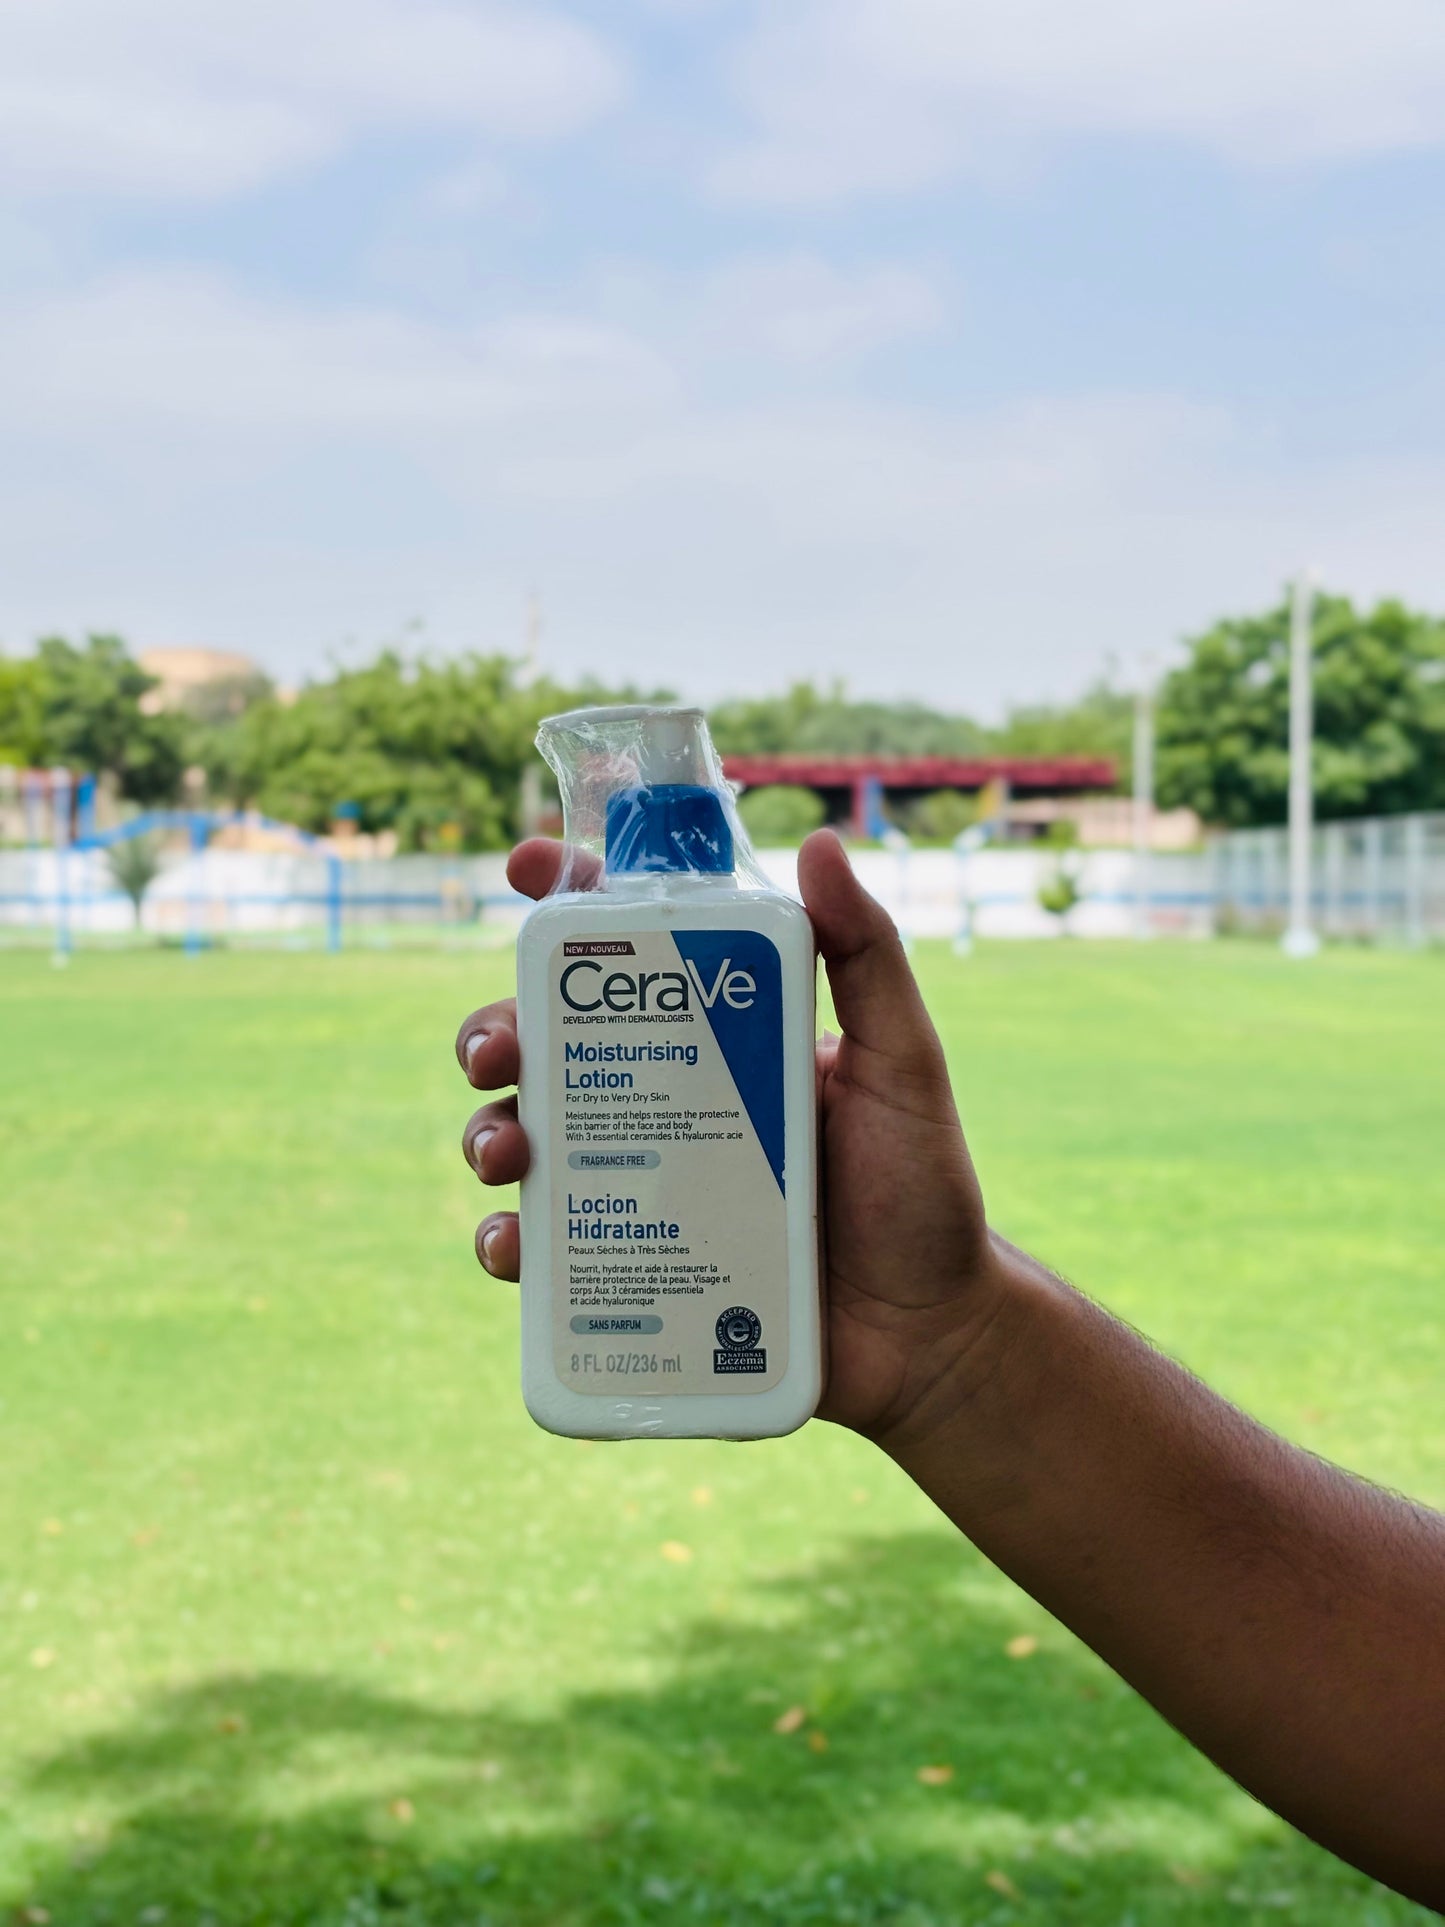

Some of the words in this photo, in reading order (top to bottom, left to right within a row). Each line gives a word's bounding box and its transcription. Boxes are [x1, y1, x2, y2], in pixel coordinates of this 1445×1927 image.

[590, 945, 628, 954] NOUVEAU
[560, 958, 756, 1012] CeraVe
[563, 1016, 606, 1024] DEVELOPED
[608, 1015, 626, 1024] WITH
[628, 1014, 694, 1024] DERMATOLOGISTS
[565, 1041, 698, 1066] Moisturising
[566, 1068, 634, 1088] Lotion
[566, 1094, 581, 1102] For
[583, 1094, 598, 1104] Dry
[600, 1094, 610, 1102] to
[612, 1093, 630, 1104] Very
[633, 1093, 648, 1104] Dry
[650, 1092, 670, 1102] Skin
[613, 1110, 628, 1120] and
[630, 1110, 651, 1121] helps
[653, 1110, 682, 1119] restore
[684, 1110, 697, 1118] the
[699, 1110, 740, 1120] protective
[566, 1122, 582, 1130] skin
[584, 1122, 611, 1130] barrier
[613, 1121, 622, 1130] of
[623, 1121, 636, 1130] the
[638, 1120, 654, 1130] face
[656, 1120, 671, 1130] and
[673, 1120, 692, 1131] body
[566, 1132, 584, 1142] With
[586, 1132, 592, 1141] 3
[593, 1132, 628, 1141] essential
[630, 1132, 672, 1140] ceramides
[675, 1132, 681, 1140] &
[682, 1131, 725, 1142] hyaluronic
[581, 1156, 624, 1166] FRAGRANCE
[627, 1156, 646, 1166] FREE
[568, 1194, 638, 1214] Locion
[568, 1218, 680, 1239] Hidratante
[568, 1246, 594, 1254] Peaux
[630, 1245, 636, 1254] à
[637, 1244, 656, 1254] Très
[602, 1264, 632, 1275] hydrate
[634, 1265, 643, 1273] et
[645, 1264, 662, 1273] aide
[670, 1264, 708, 1272] restaurer
[710, 1264, 718, 1272] la
[570, 1275, 600, 1284] barrière
[602, 1276, 646, 1285] protectrice
[648, 1275, 658, 1284] de
[660, 1275, 668, 1284] la
[694, 1274, 721, 1285] Visage
[722, 1275, 731, 1283] et
[570, 1286, 592, 1296] corps
[594, 1286, 610, 1294] Aux
[612, 1286, 617, 1294] 3
[619, 1286, 660, 1294] céramides
[570, 1297, 578, 1306] et
[580, 1296, 600, 1306] acide
[602, 1296, 655, 1307] hyaluronique
[721, 1308, 756, 1322] ACCEPTED
[589, 1320, 609, 1330] SANS
[611, 1320, 642, 1330] PARFUM
[571, 1354, 580, 1373] 8
[584, 1354, 602, 1373] FL
[606, 1353, 658, 1374] OZ/236
[662, 1354, 682, 1373] ml
[716, 1353, 764, 1364] Eczema
